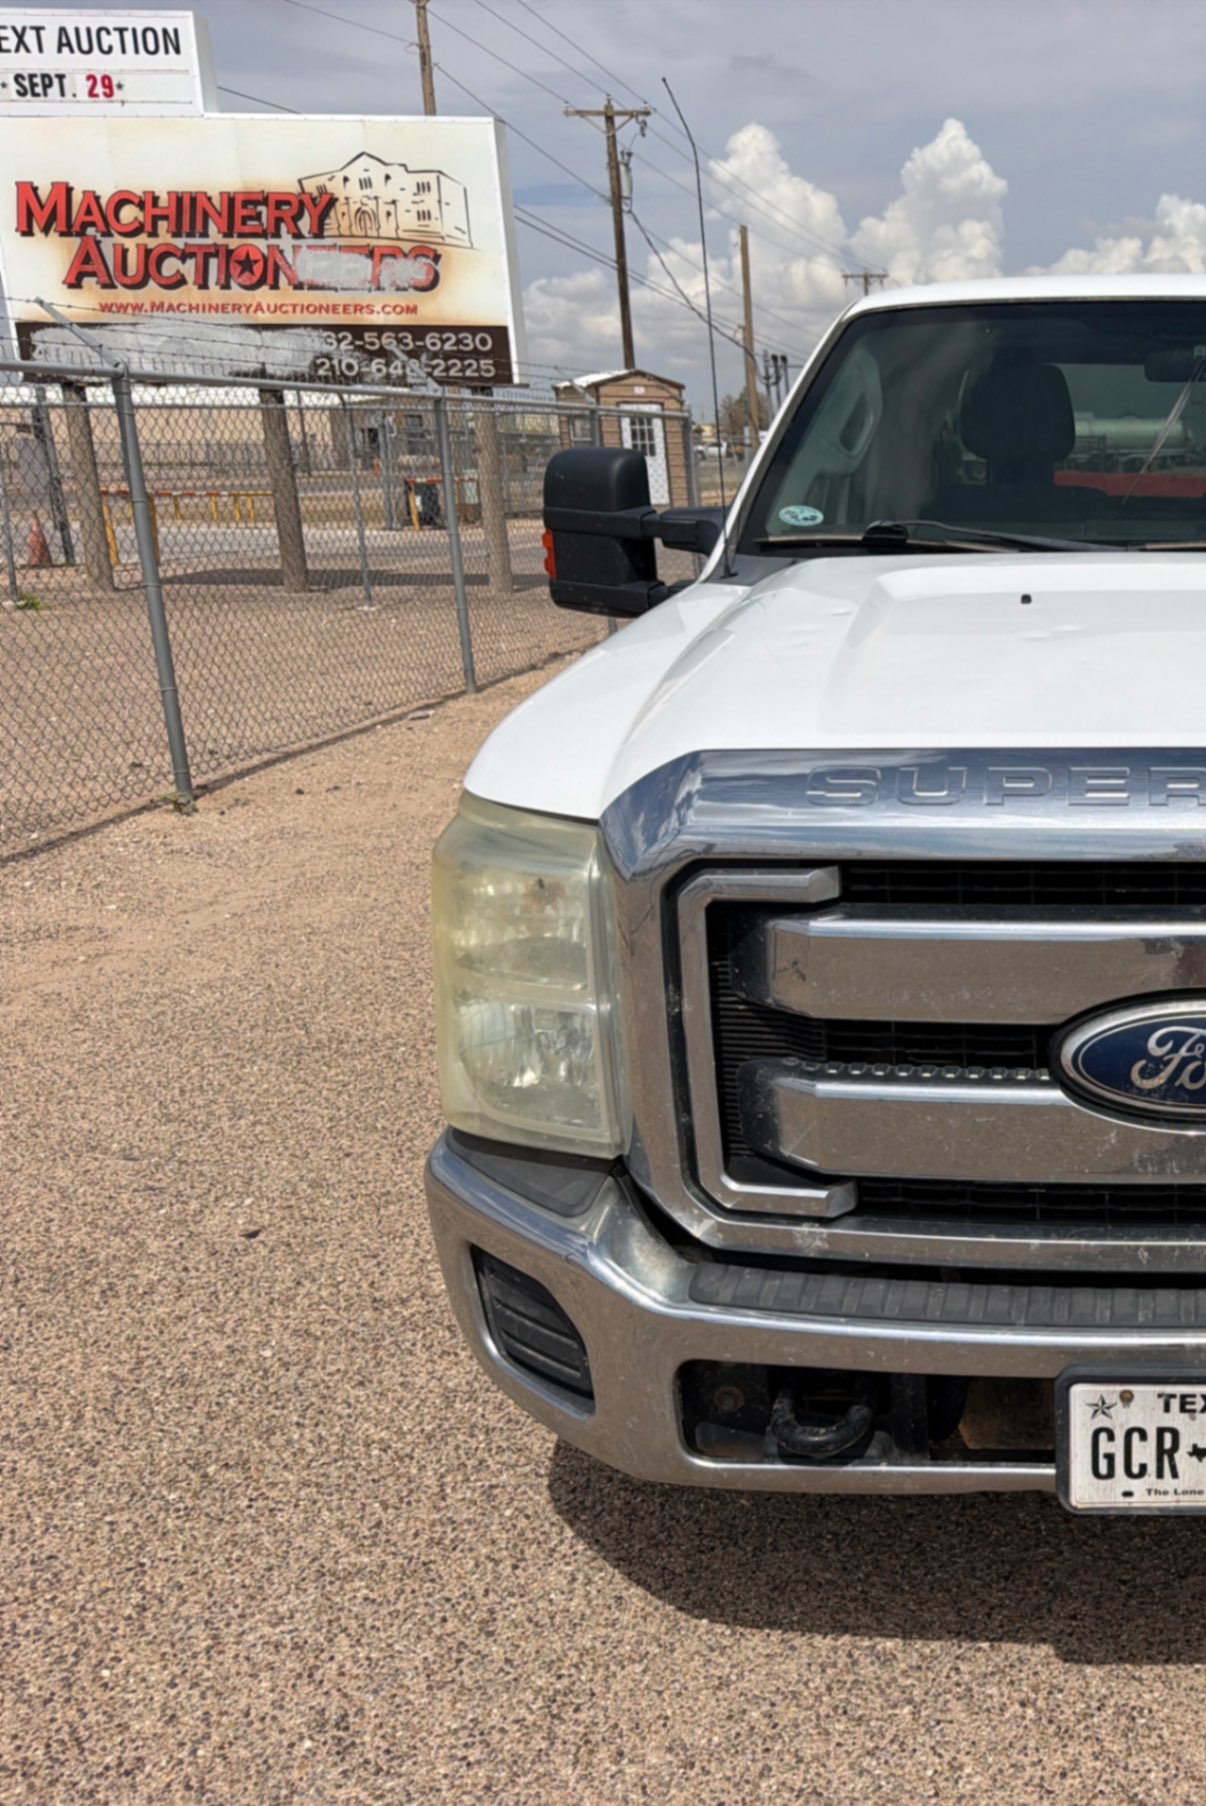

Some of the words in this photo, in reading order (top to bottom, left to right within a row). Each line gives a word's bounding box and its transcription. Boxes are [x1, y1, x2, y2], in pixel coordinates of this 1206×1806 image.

[56, 26, 181, 55] AUCTION
[13, 73, 77, 98] SEPT.
[85, 74, 115, 98] 29
[15, 181, 335, 238] MACHINERY
[1091, 1426, 1180, 1480] GCR
[1146, 1488, 1168, 1496] The
[1173, 1488, 1204, 1496] Lone
